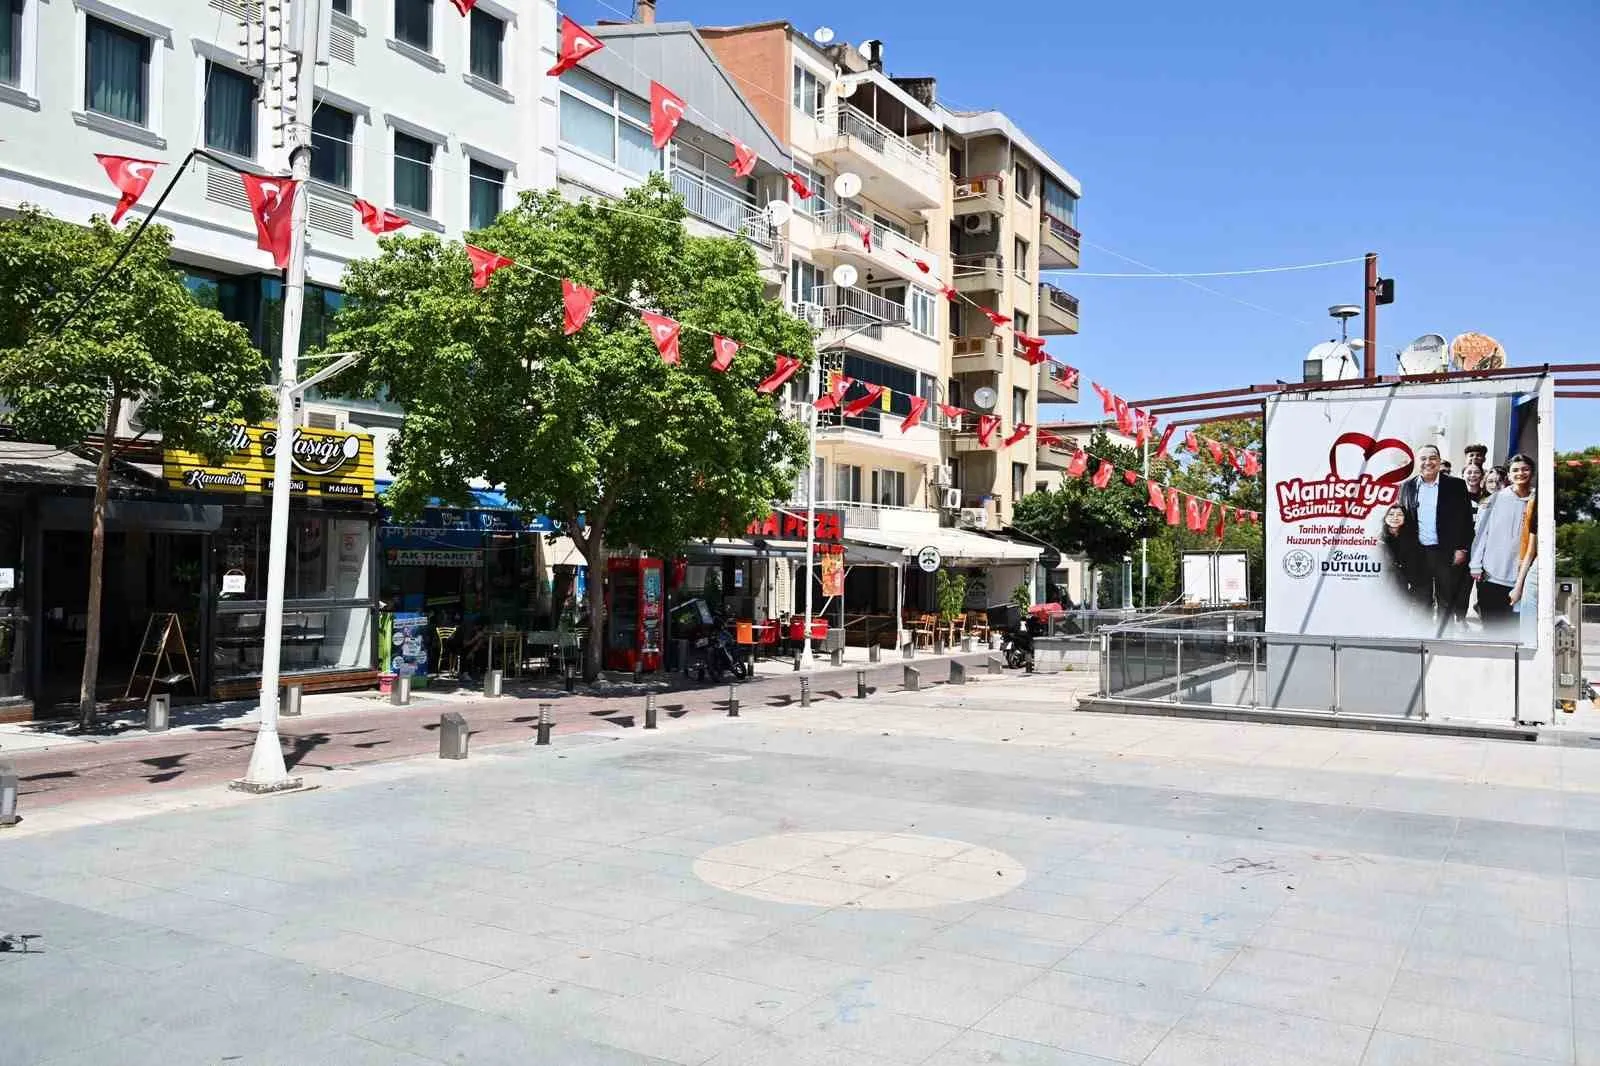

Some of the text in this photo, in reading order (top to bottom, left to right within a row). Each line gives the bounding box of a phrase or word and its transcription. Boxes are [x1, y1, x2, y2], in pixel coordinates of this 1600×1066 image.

[328, 485, 359, 494] MANİSA
[1278, 476, 1396, 506] Manisa'ya
[1283, 500, 1368, 520] Sözümüz Var
[1299, 525, 1365, 535] Tarihin Kalbinde
[1286, 536, 1378, 547] Huzurun Şehrindesiniz
[1333, 550, 1369, 561] Besim
[1321, 561, 1381, 573] DUTLULU
